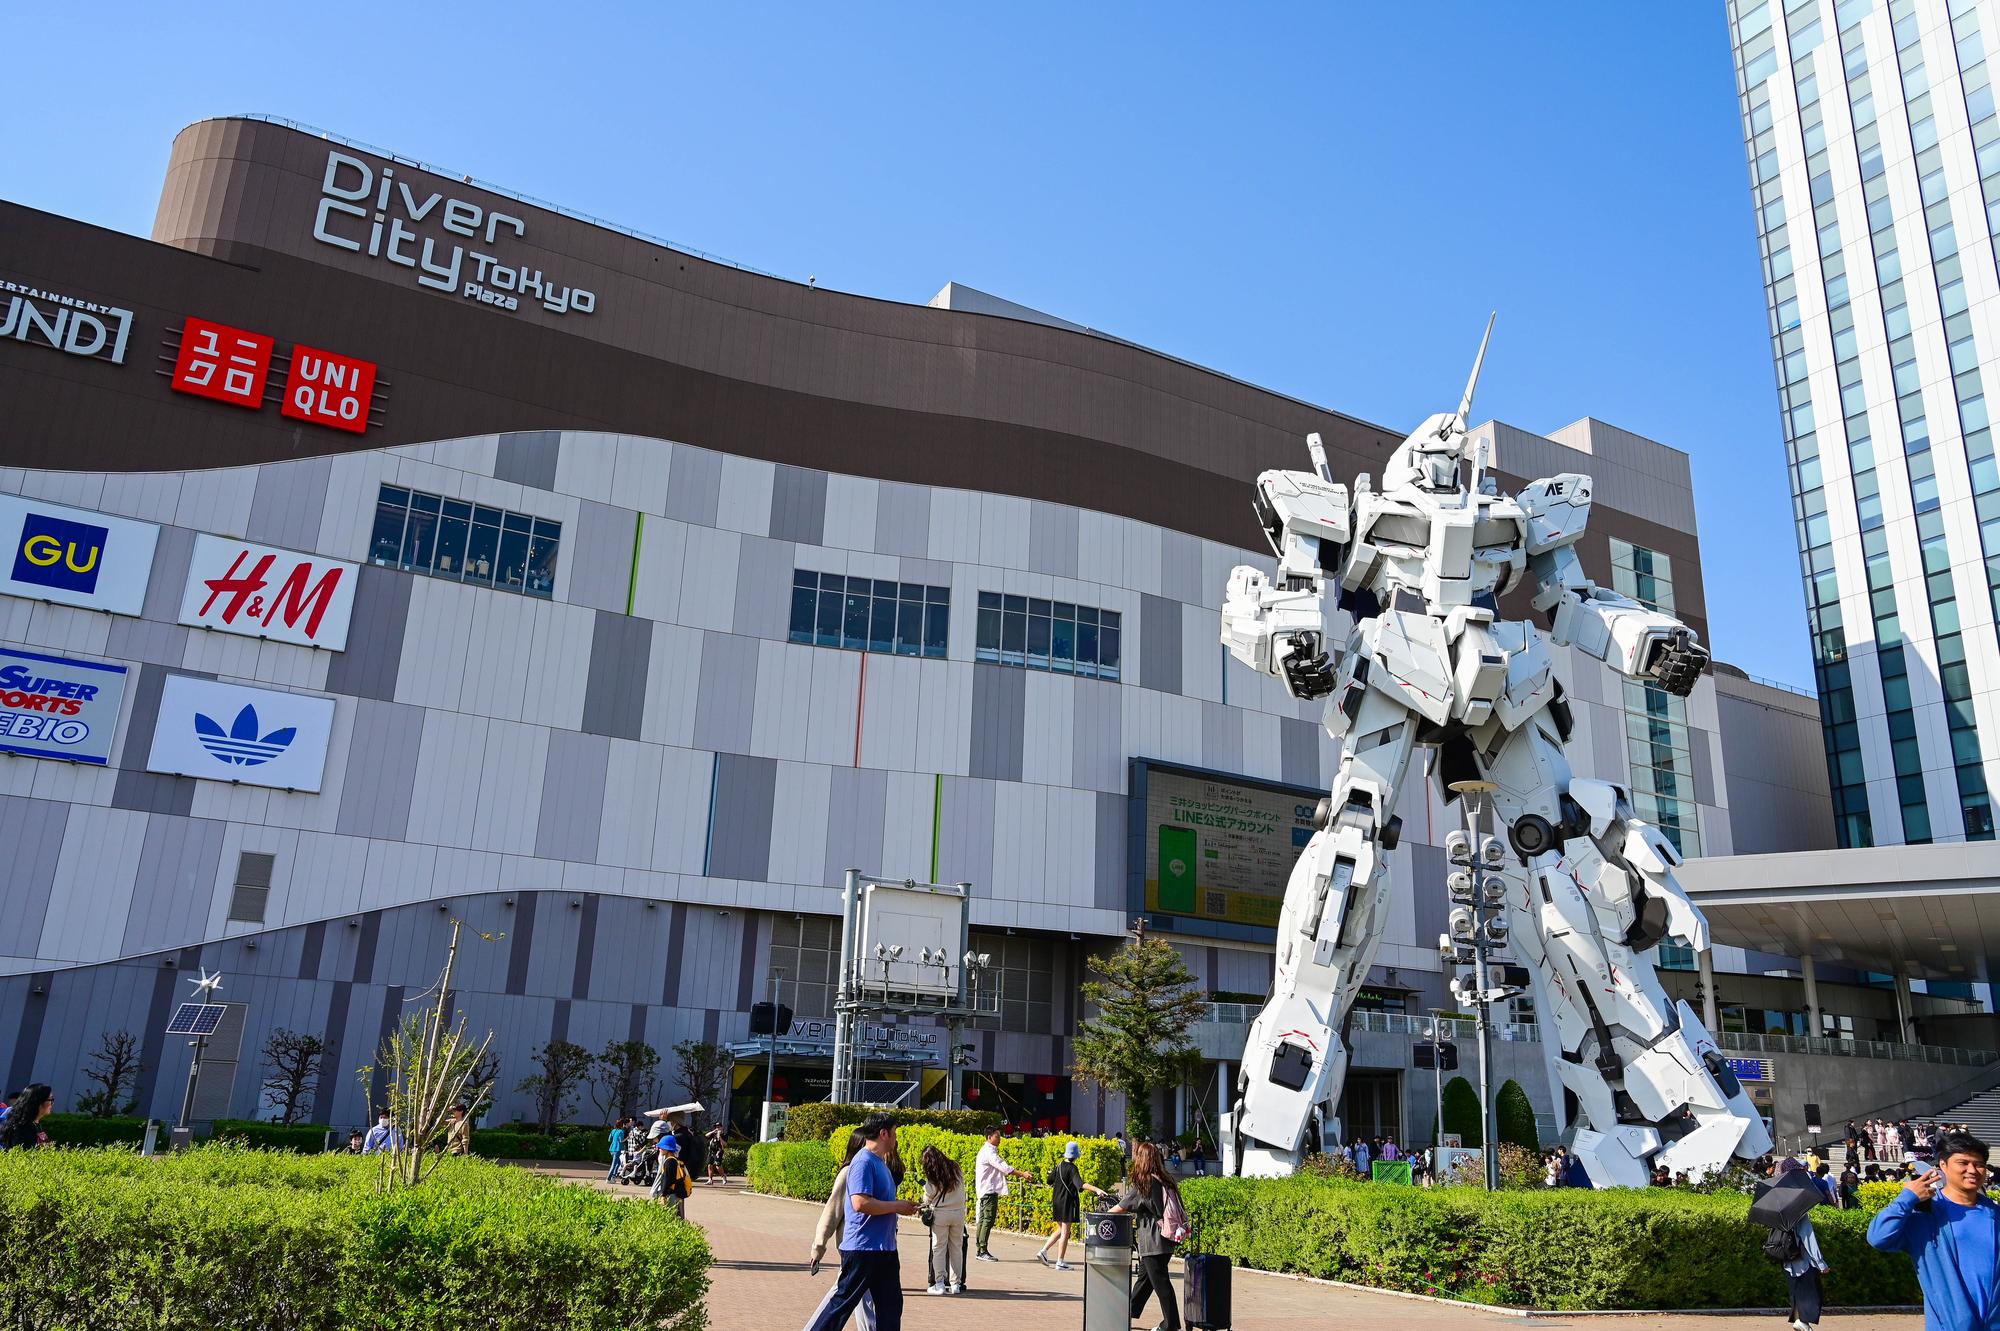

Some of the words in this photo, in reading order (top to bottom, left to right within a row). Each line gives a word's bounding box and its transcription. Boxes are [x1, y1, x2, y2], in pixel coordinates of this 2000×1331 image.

[322, 151, 525, 243] Diver
[313, 198, 463, 293] City
[469, 251, 596, 313] Tokyo
[463, 281, 518, 311] Plaza
[194, 330, 257, 366] ユニ
[184, 360, 254, 396] クロ
[300, 355, 360, 392] UNI
[294, 385, 359, 420] QLO
[23, 534, 99, 574] GU
[199, 550, 344, 640] H&M
[0, 665, 98, 701] SUPER
[1169, 796, 1280, 822] 三井ショッピングパークポイント
[1174, 809, 1274, 834] LINE公式アカウント
